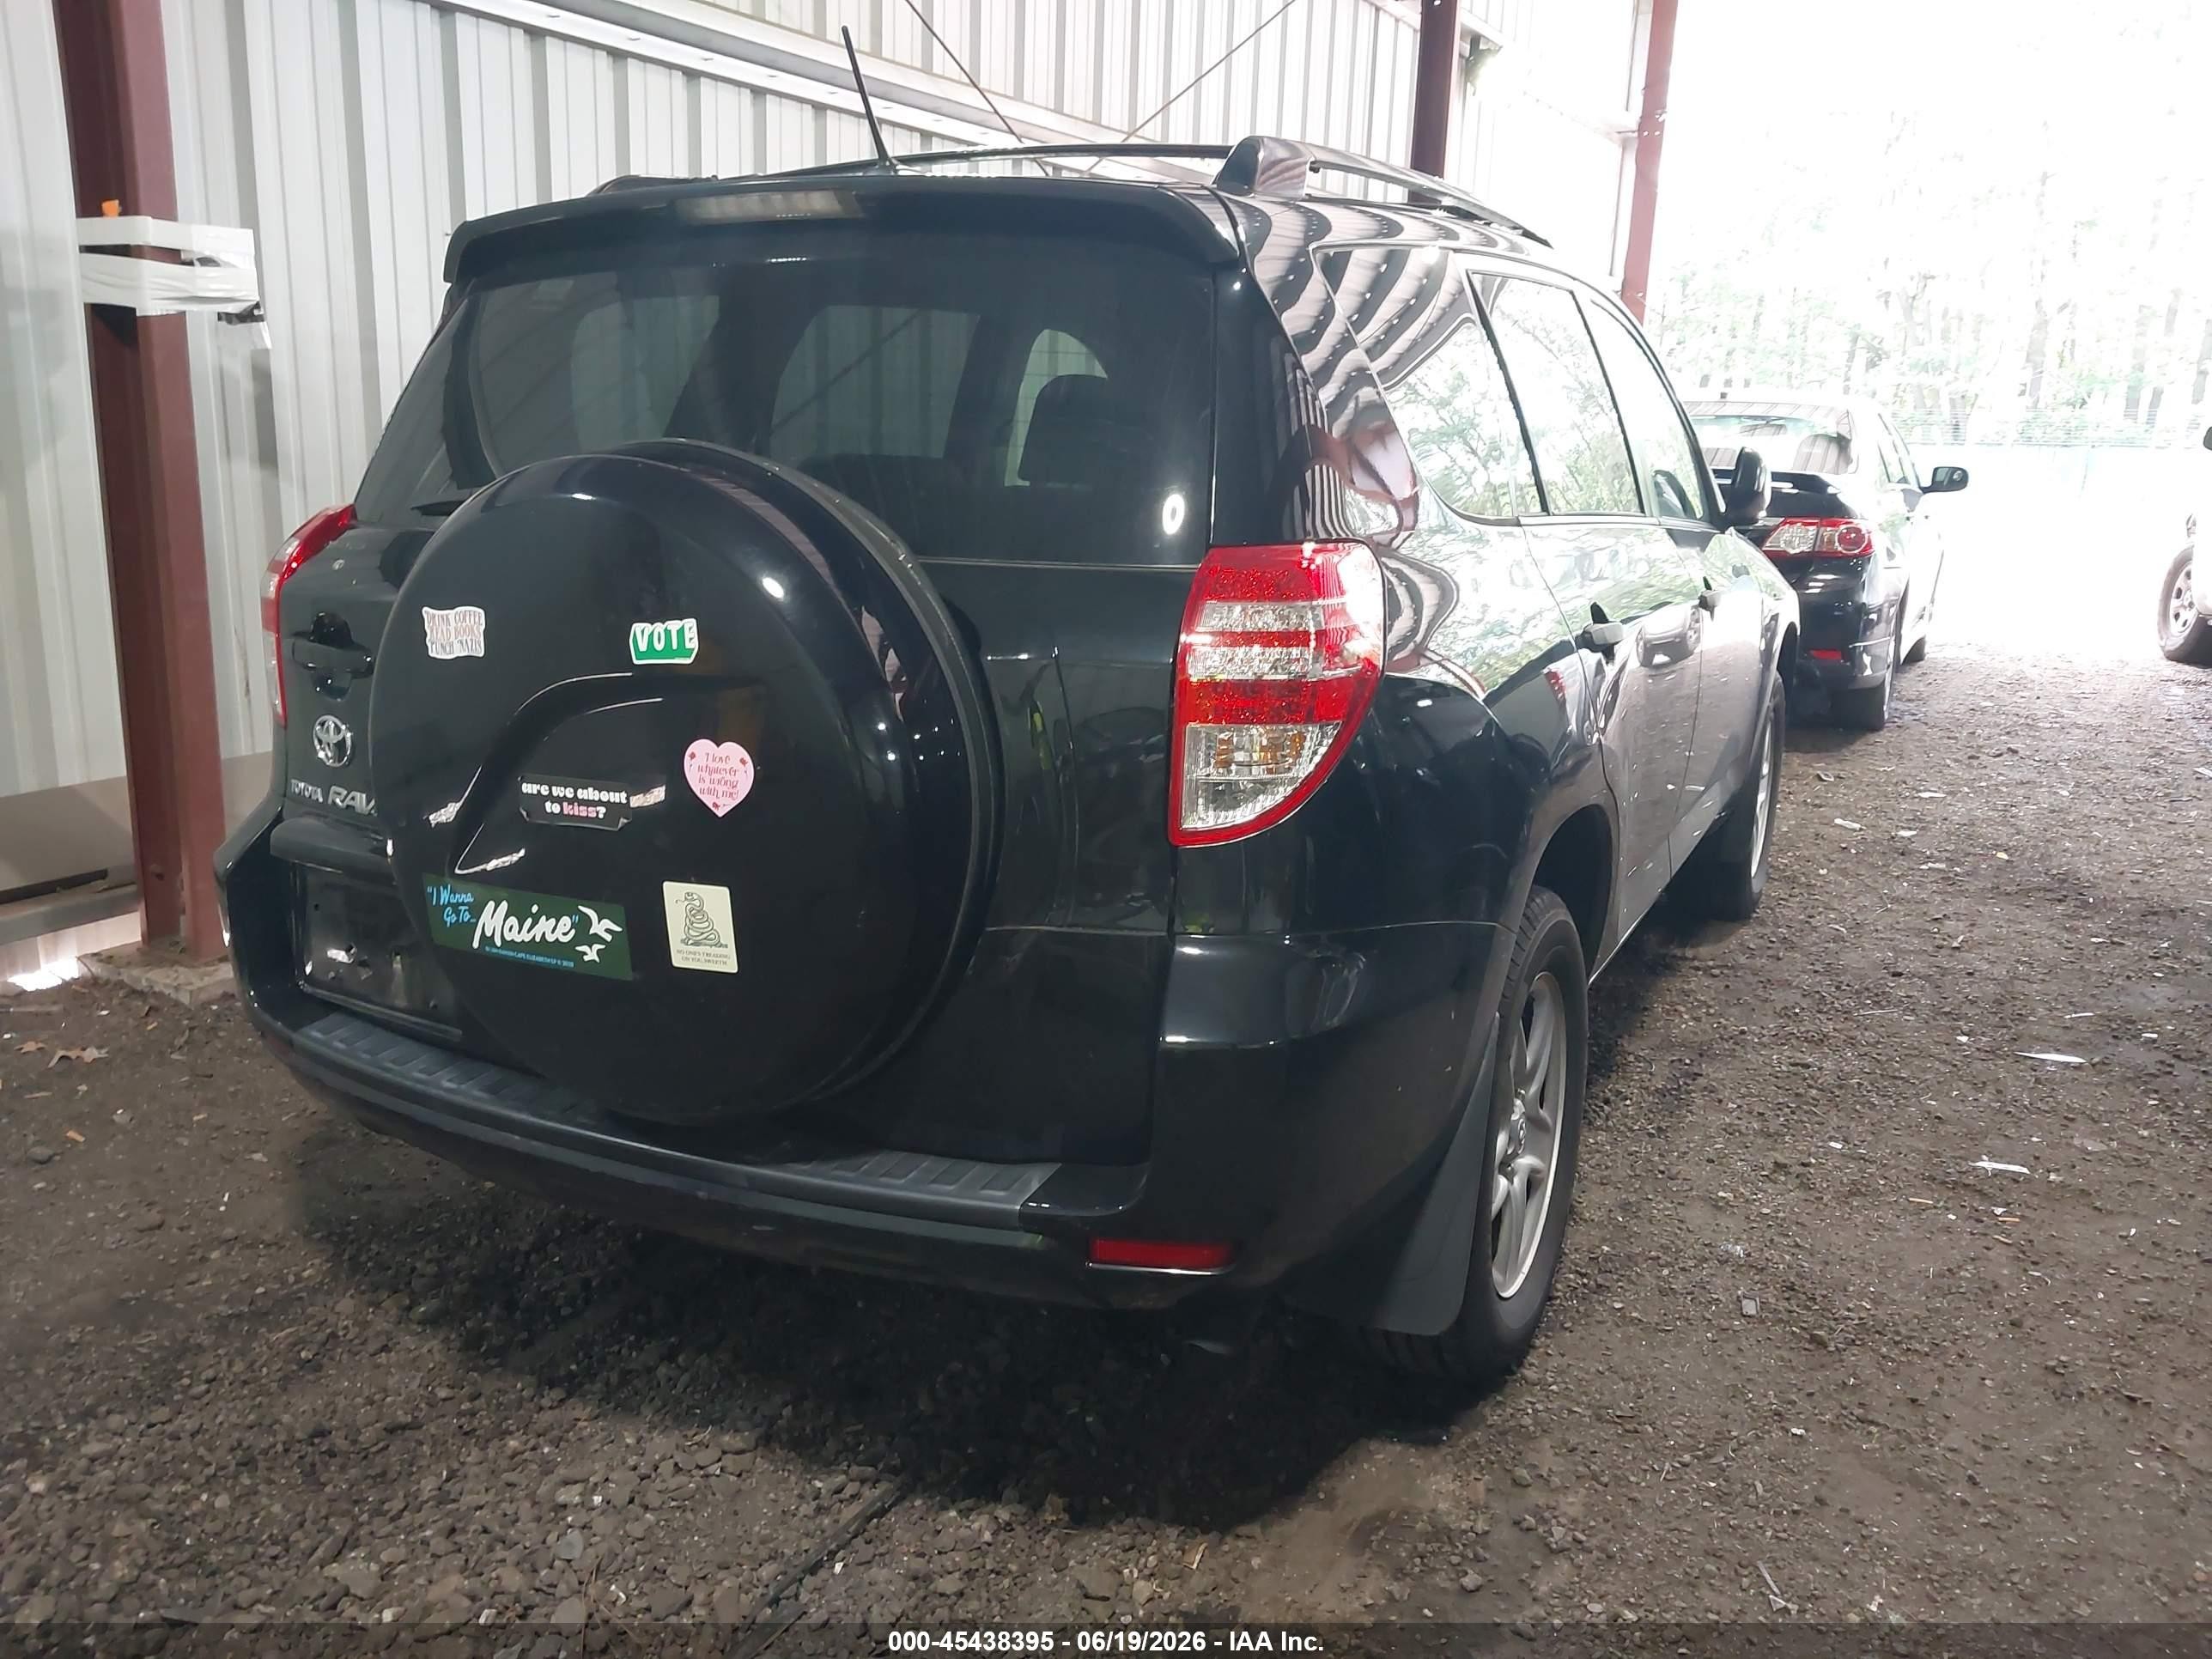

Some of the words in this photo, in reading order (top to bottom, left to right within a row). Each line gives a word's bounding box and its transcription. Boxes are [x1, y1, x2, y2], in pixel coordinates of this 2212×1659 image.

[424, 611, 452, 627] DRINK
[453, 609, 483, 625] COFFEE
[428, 624, 452, 641] READ
[453, 623, 482, 640] BOOKS
[635, 622, 696, 652] VOTE
[428, 639, 454, 655] PUNCH
[457, 638, 482, 654] NAZIS
[705, 752, 710, 763] I
[712, 753, 731, 764] love
[697, 764, 738, 777] whatever
[291, 778, 323, 803] TOYOTA
[708, 777, 738, 789] wrong
[521, 782, 550, 796] are
[551, 786, 574, 799] we
[576, 787, 628, 804] about
[699, 787, 720, 799] with
[544, 800, 562, 814] to
[562, 801, 606, 819] kiss?
[440, 884, 474, 906] Wanna
[443, 906, 458, 927] Go
